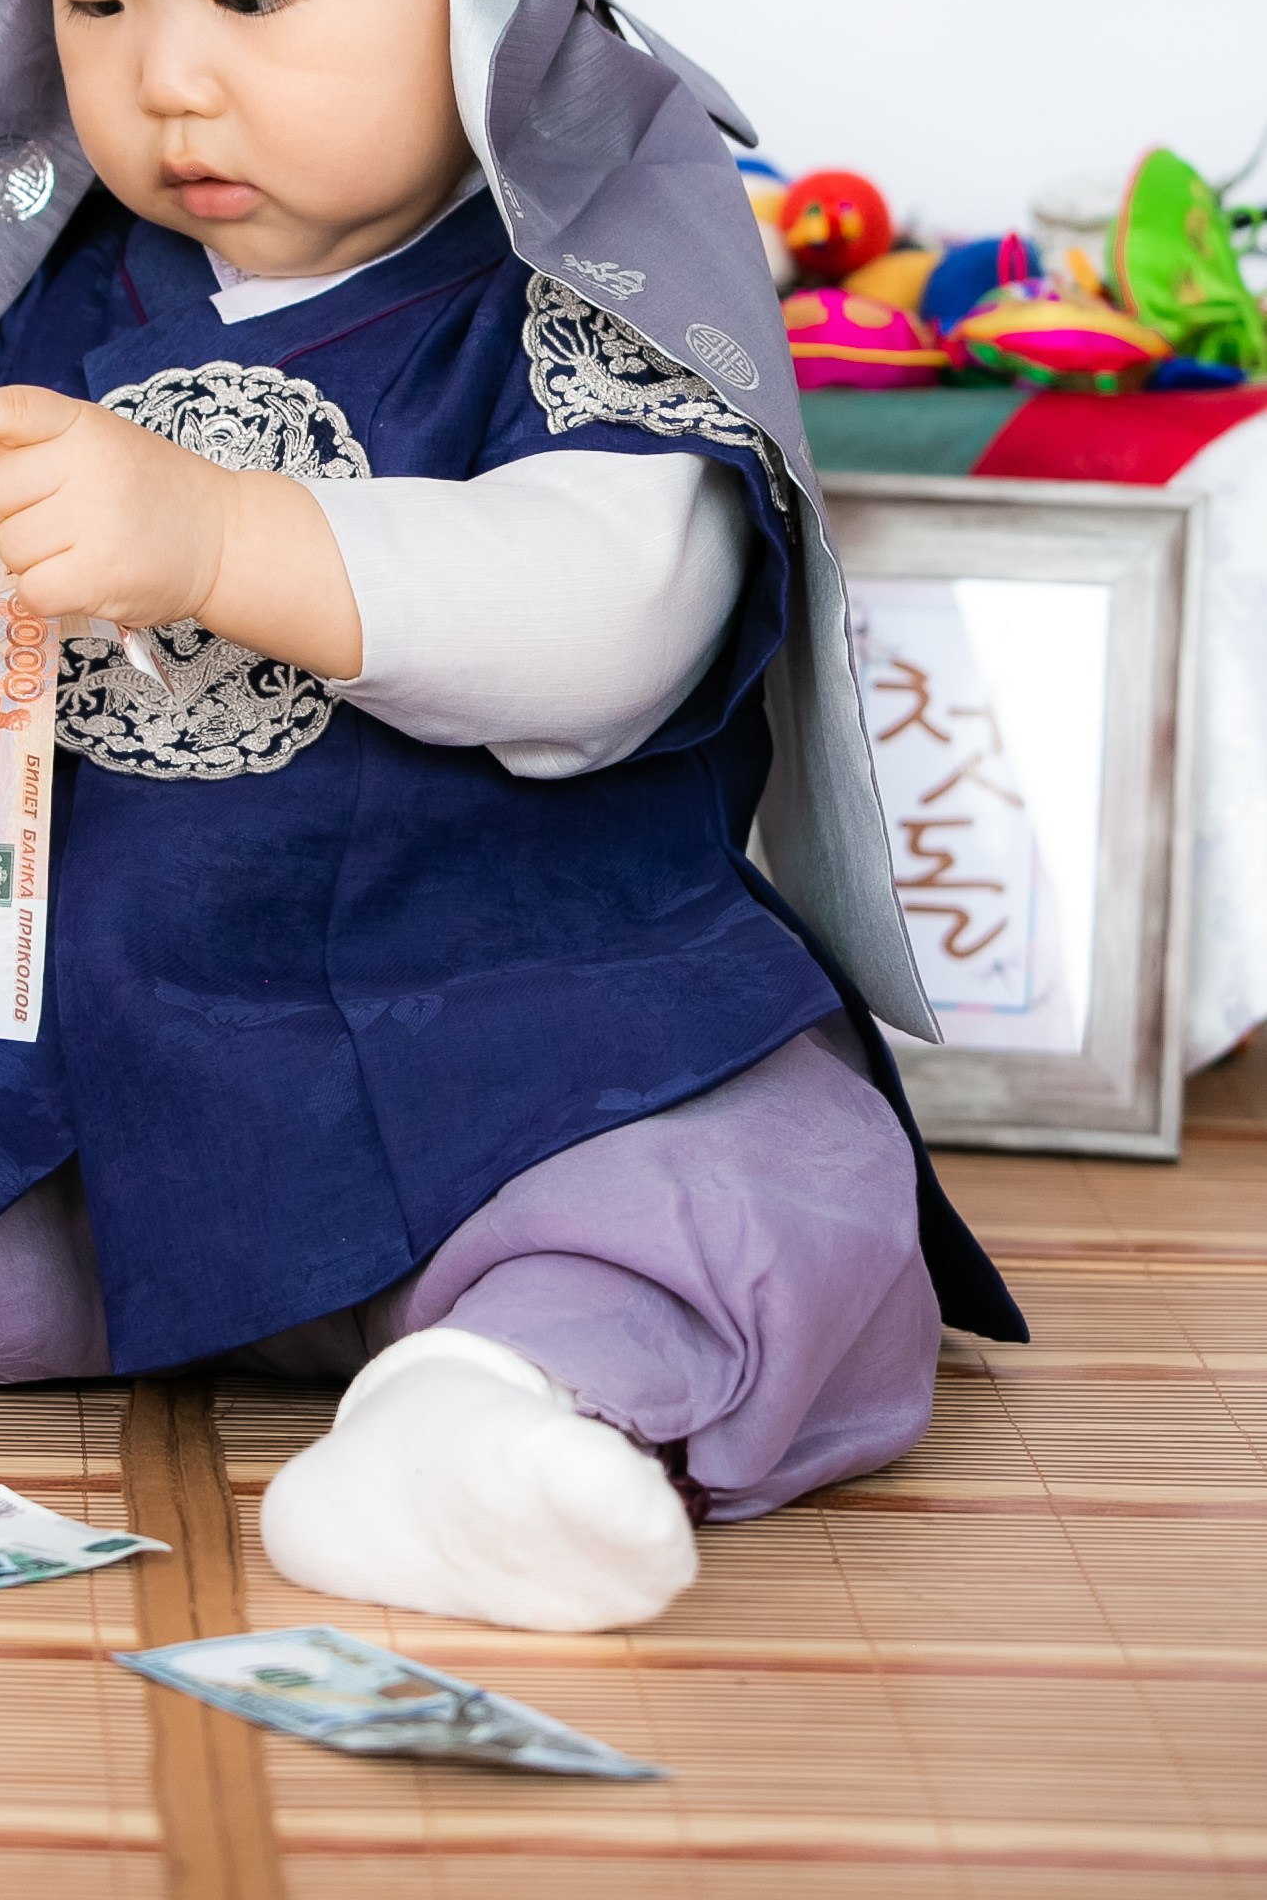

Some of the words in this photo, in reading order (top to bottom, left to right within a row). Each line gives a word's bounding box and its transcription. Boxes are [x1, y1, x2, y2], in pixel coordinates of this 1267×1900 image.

[22, 753, 41, 820] БИЛЕТ
[19, 828, 37, 899] БАНКА
[13, 907, 34, 1023] ПРИКОЛОВ
